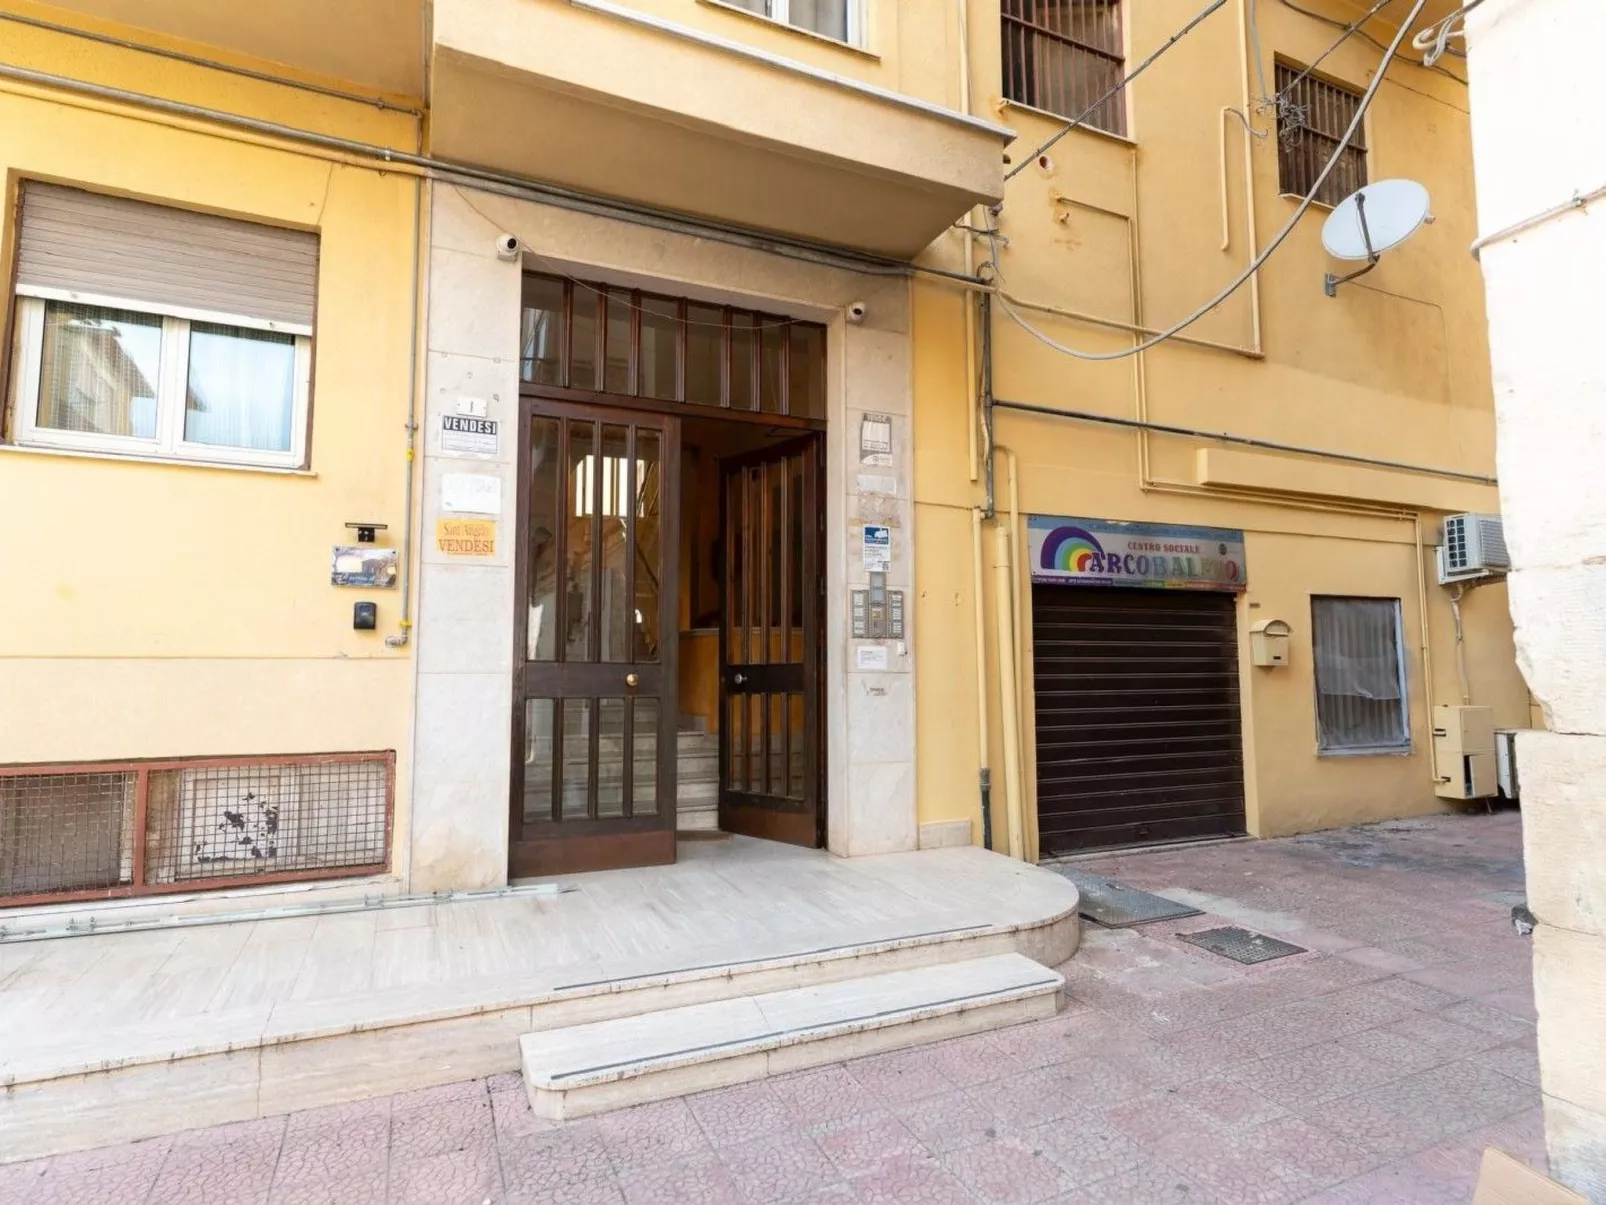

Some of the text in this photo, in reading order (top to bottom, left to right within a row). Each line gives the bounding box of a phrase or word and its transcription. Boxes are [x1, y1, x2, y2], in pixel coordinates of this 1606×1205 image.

[444, 417, 496, 434] VENDESI
[437, 539, 495, 552] VENDESI
[1127, 541, 1200, 554] CENTRO SOCIALE
